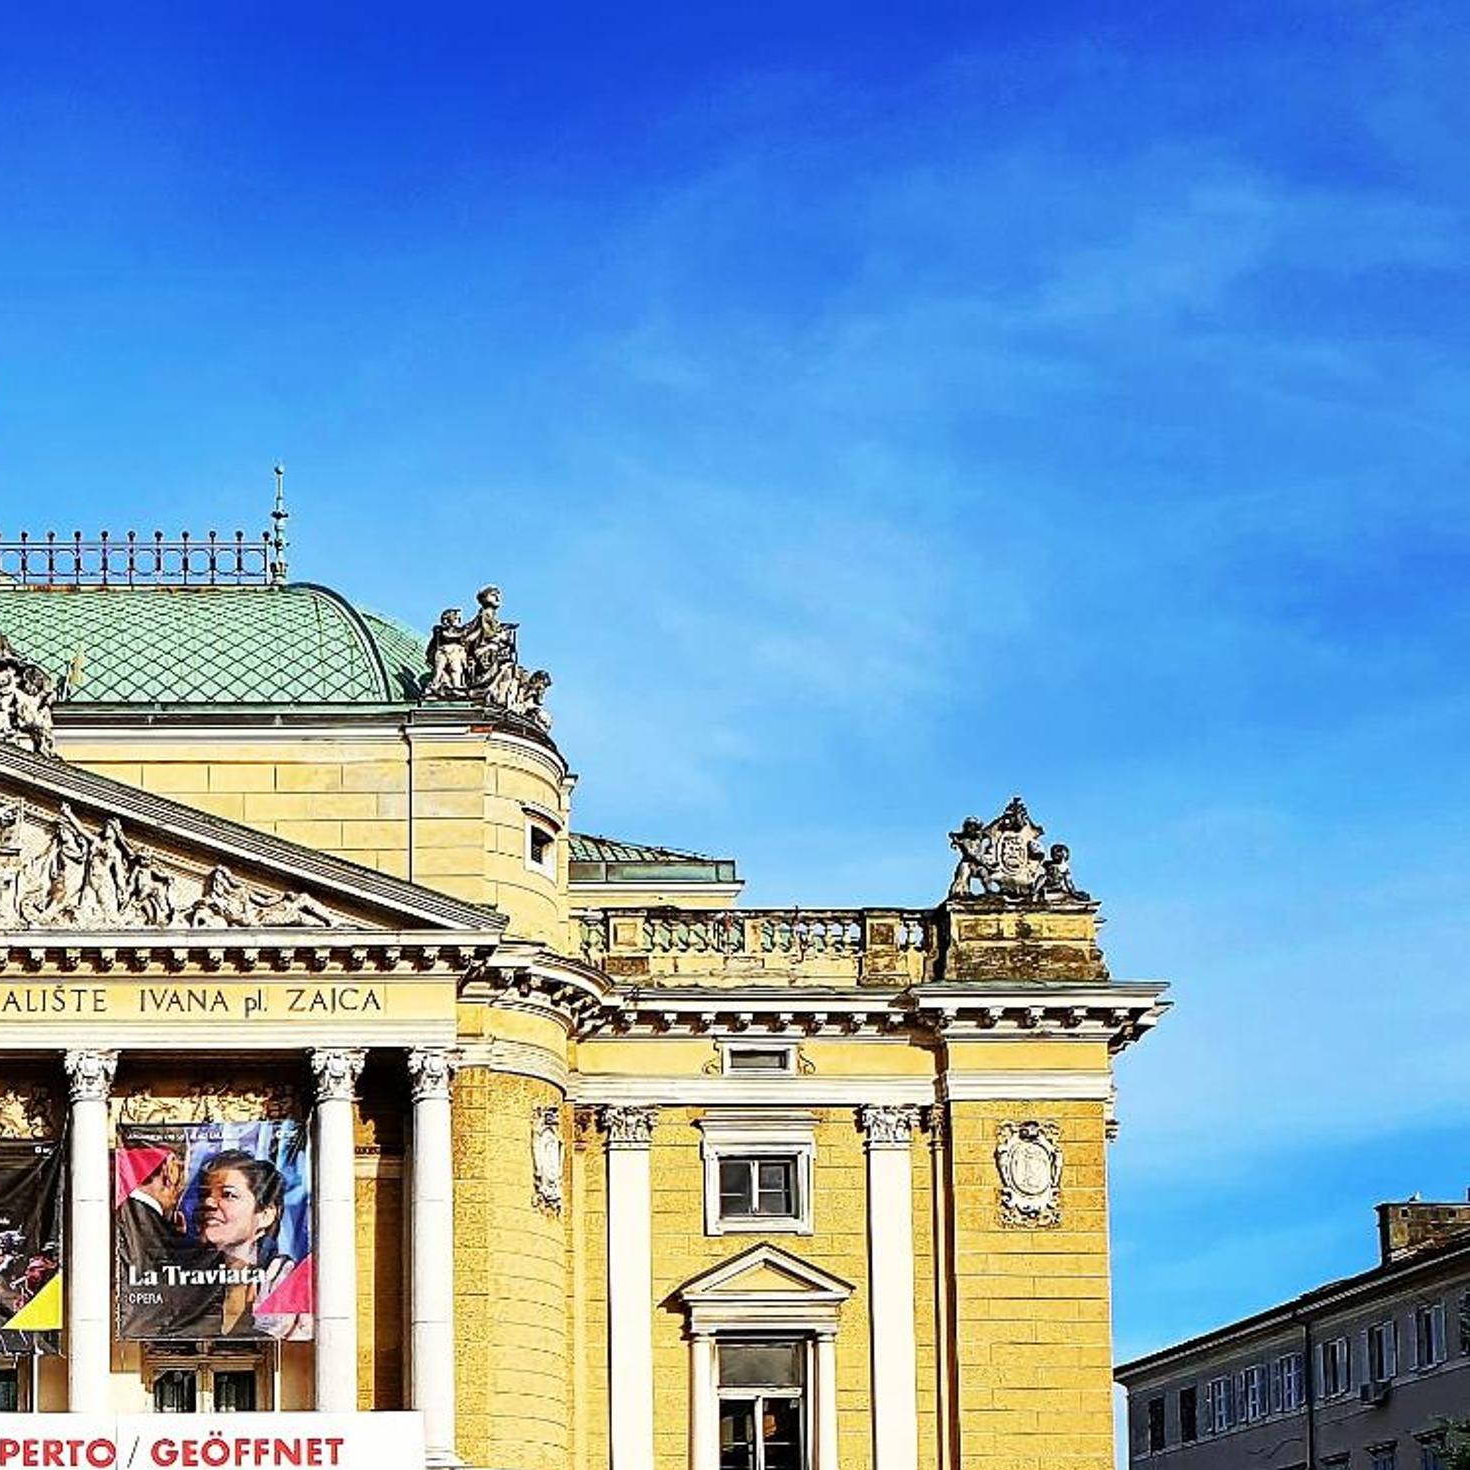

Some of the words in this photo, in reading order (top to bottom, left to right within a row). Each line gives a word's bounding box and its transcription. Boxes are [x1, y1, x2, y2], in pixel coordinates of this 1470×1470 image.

[139, 988, 230, 1012] IVANA
[244, 993, 268, 1018] pl.
[286, 987, 382, 1014] ZAJCA
[129, 1265, 159, 1286] La
[162, 1263, 267, 1287] Traviata
[128, 1292, 164, 1305] OPERA
[150, 1430, 344, 1468] GEÖFFNET
